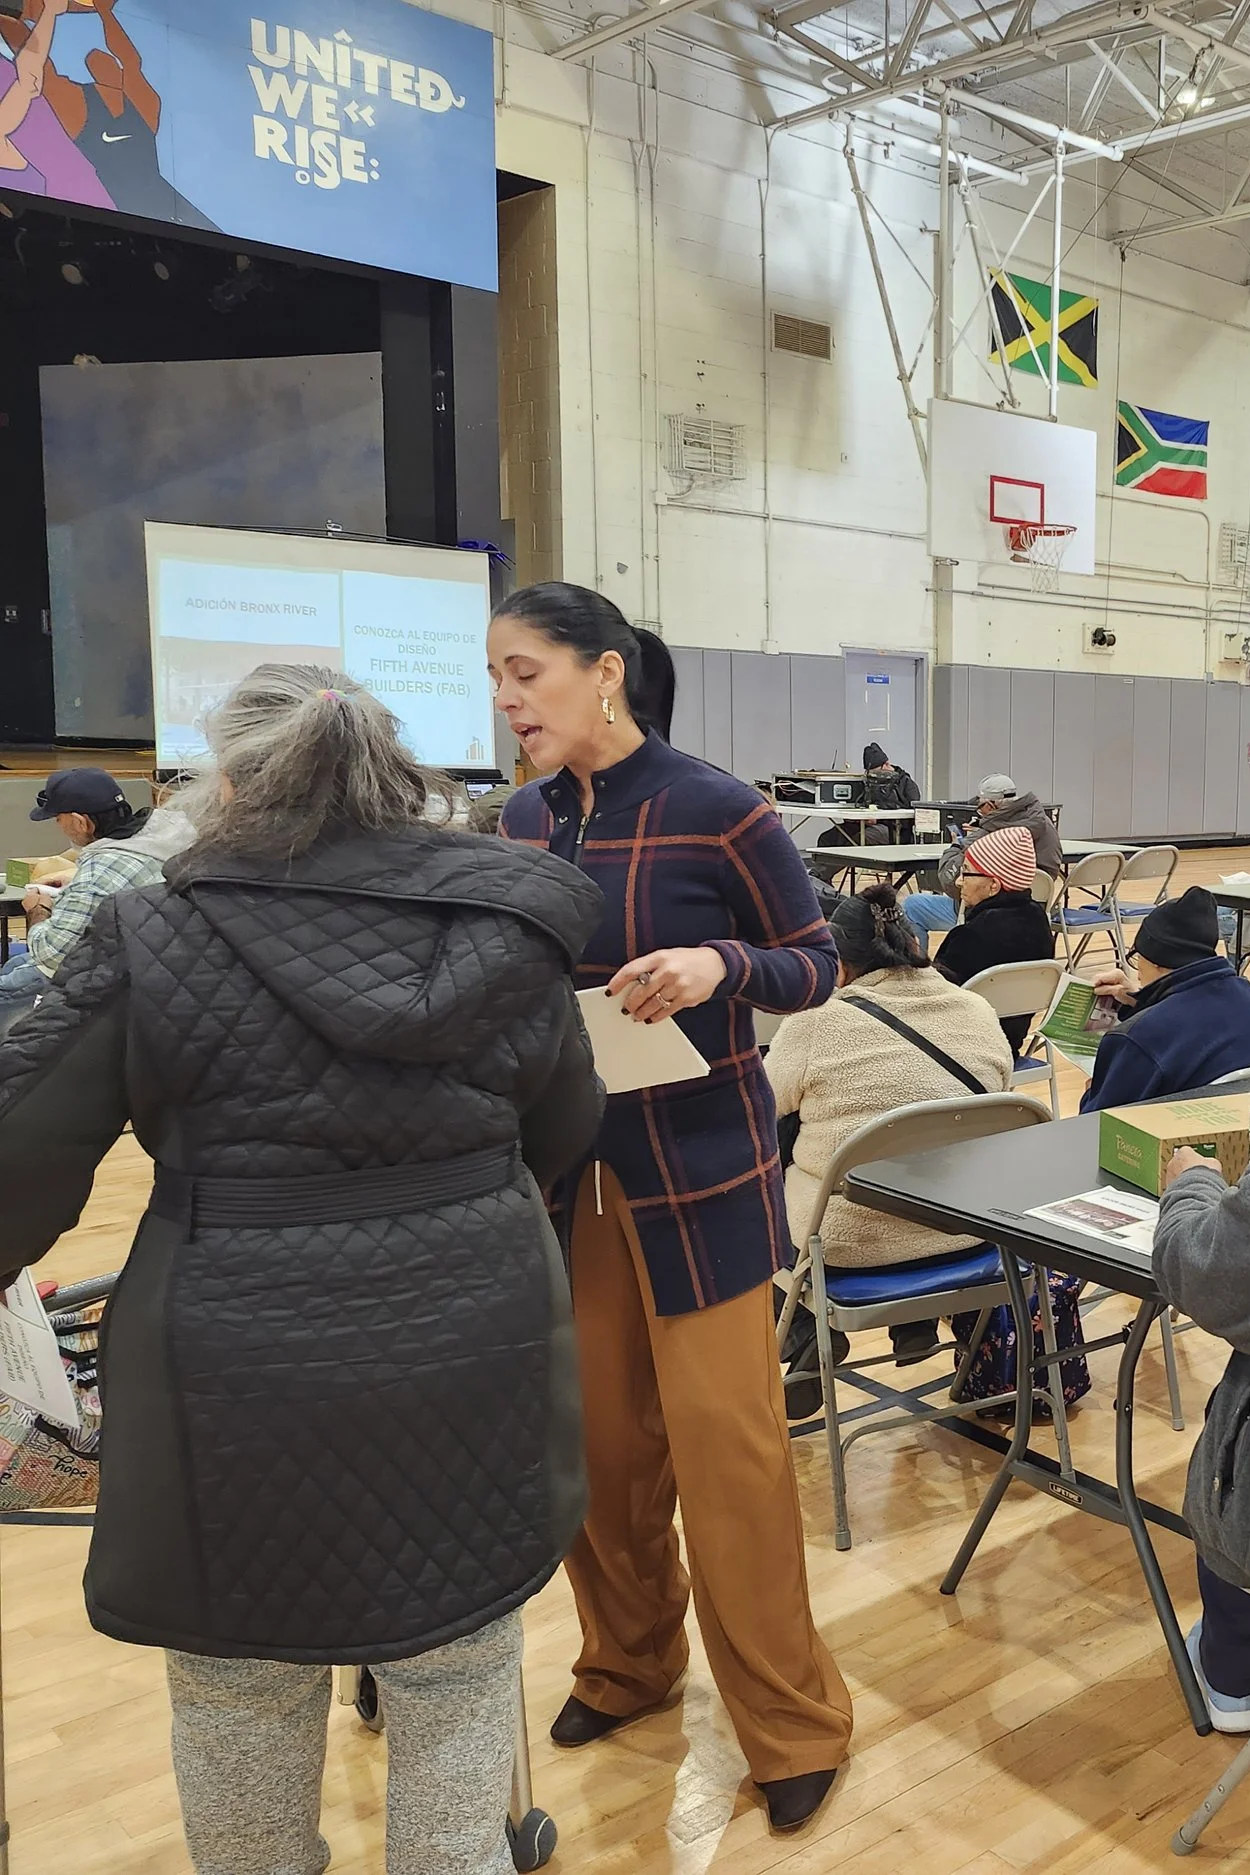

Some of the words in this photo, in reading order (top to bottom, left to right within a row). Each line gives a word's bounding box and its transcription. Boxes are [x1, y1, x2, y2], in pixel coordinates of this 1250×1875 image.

[185, 597, 236, 611] ADICIÓN
[240, 601, 280, 614] BRONX
[283, 604, 317, 617] RIVER
[353, 624, 405, 640] CONOZCA
[407, 630, 421, 641] AL
[423, 630, 460, 643] EQUIPO
[463, 633, 477, 644] DE
[398, 643, 437, 656] DISEÑO
[370, 658, 408, 673] FIFTH
[412, 660, 464, 676] AVENUE
[364, 678, 433, 694] BUILDERS
[437, 681, 471, 699] (FAB)
[49, 1454, 88, 1479] hope
